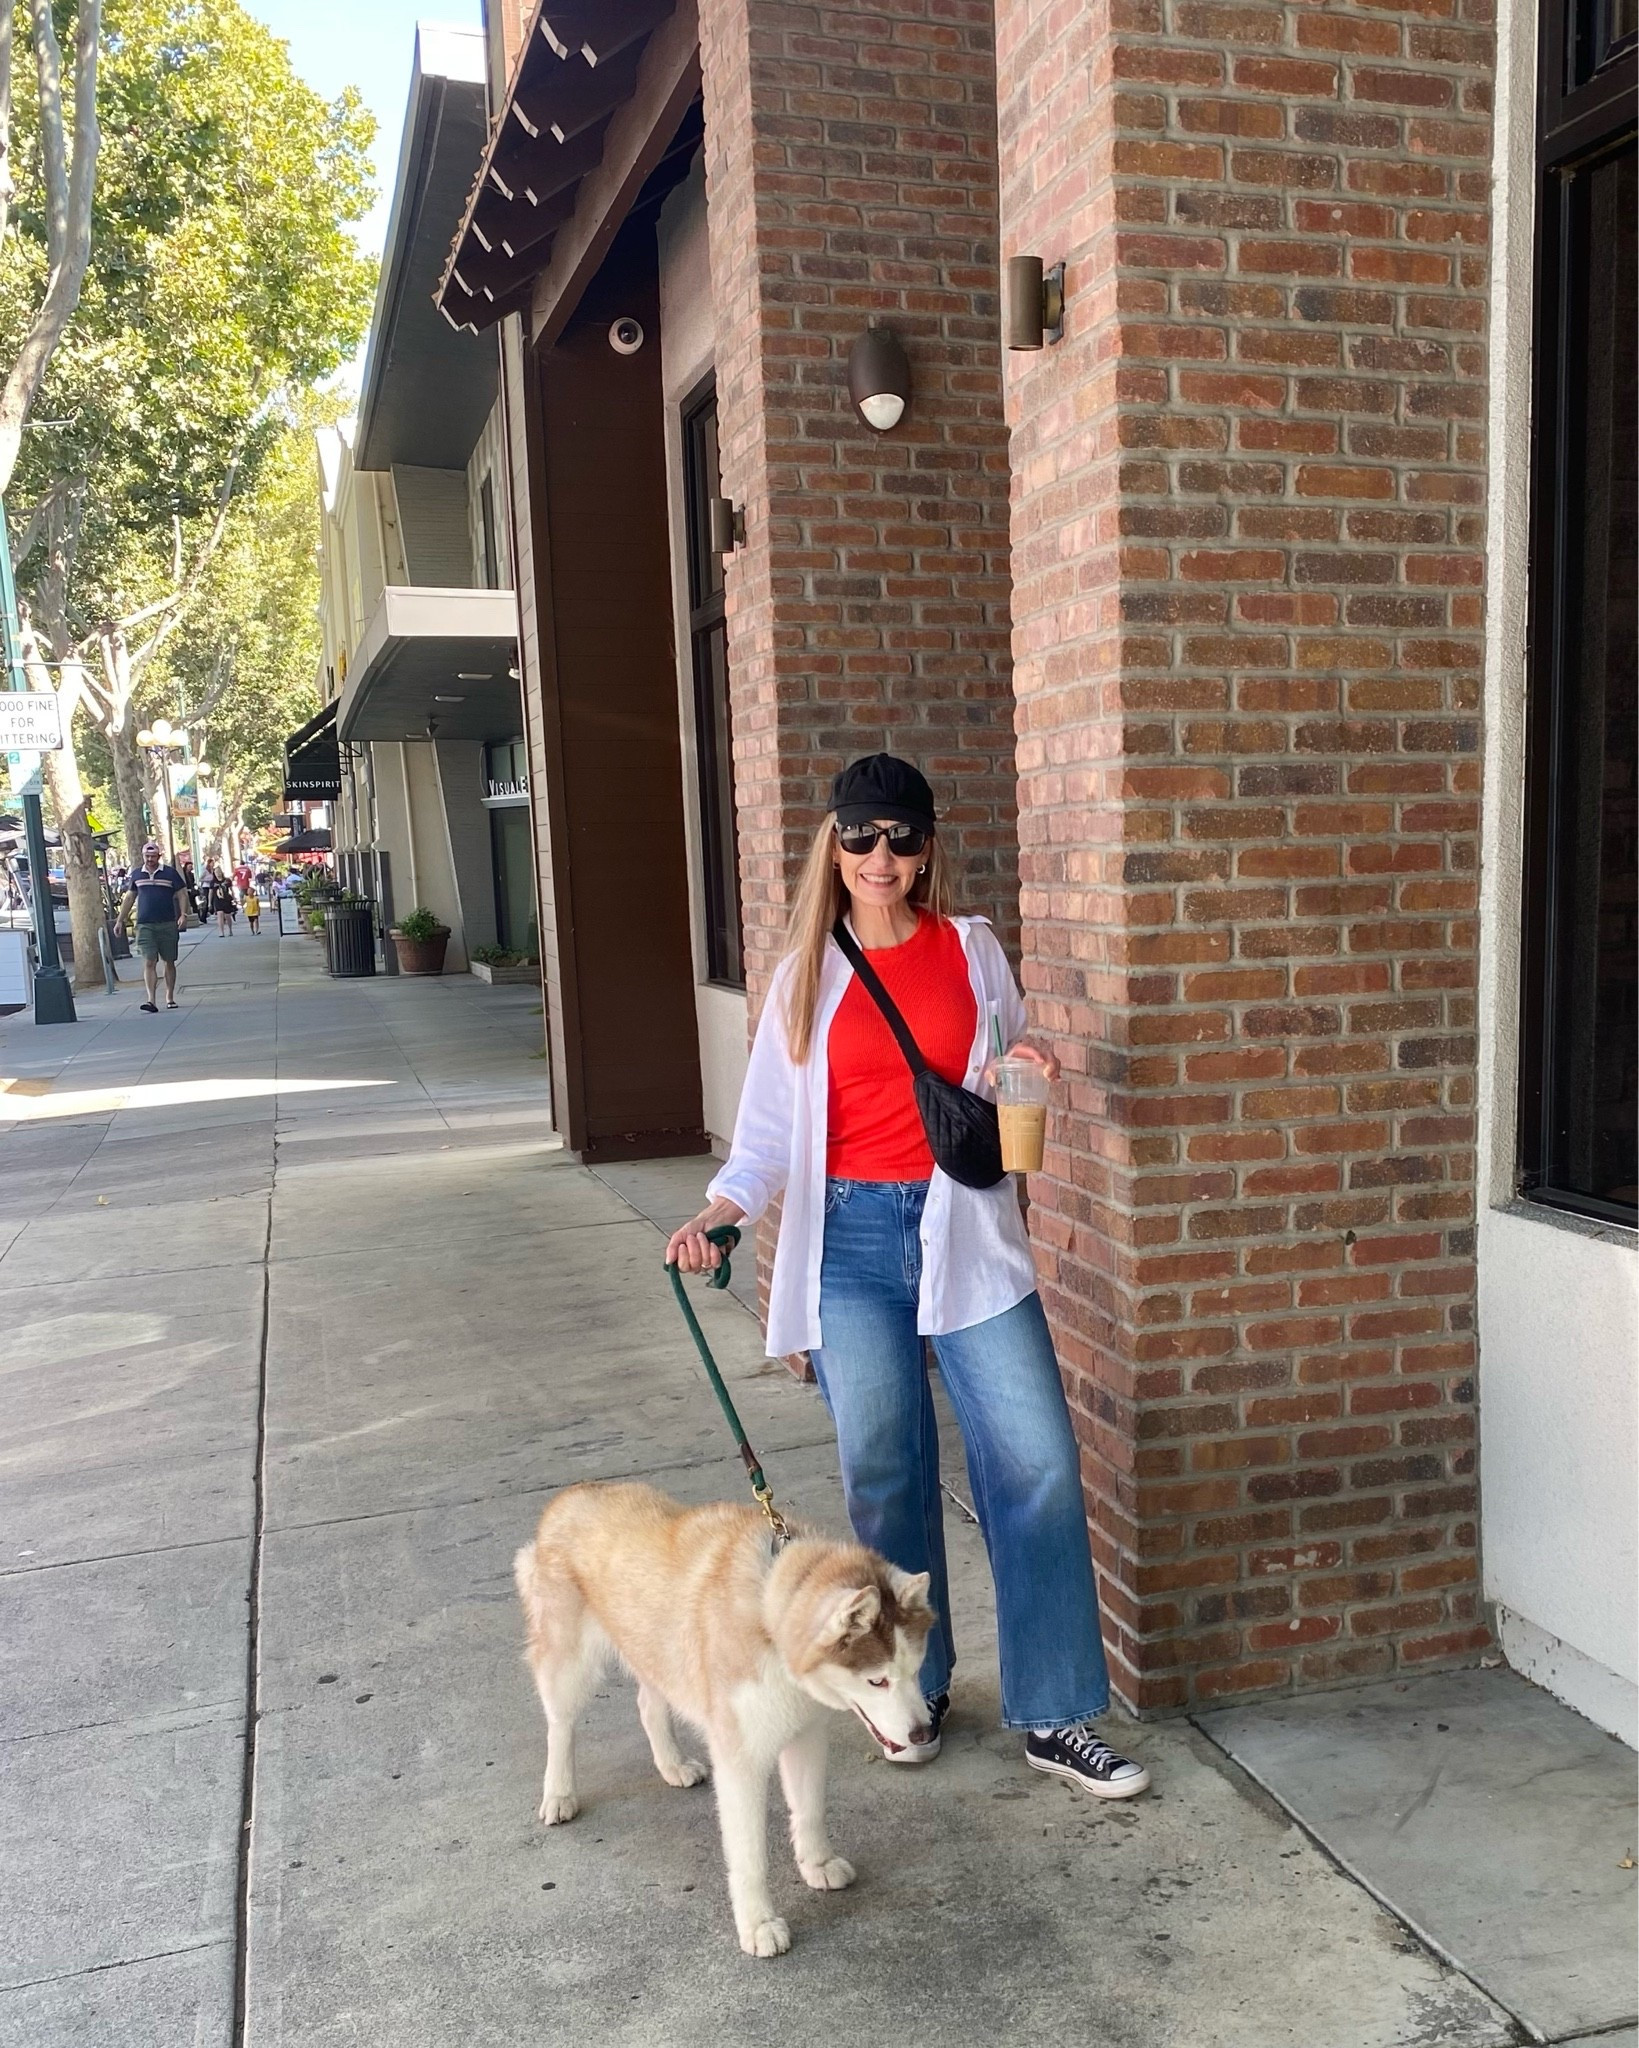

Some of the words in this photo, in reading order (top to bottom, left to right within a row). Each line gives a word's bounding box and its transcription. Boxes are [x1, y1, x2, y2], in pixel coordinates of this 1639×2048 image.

[27, 700, 55, 711] FINE
[10, 717, 35, 728] FOR
[0, 732, 57, 744] ITTERING
[285, 780, 341, 789] SKINSPIRIT
[240, 871, 246, 879] 7
